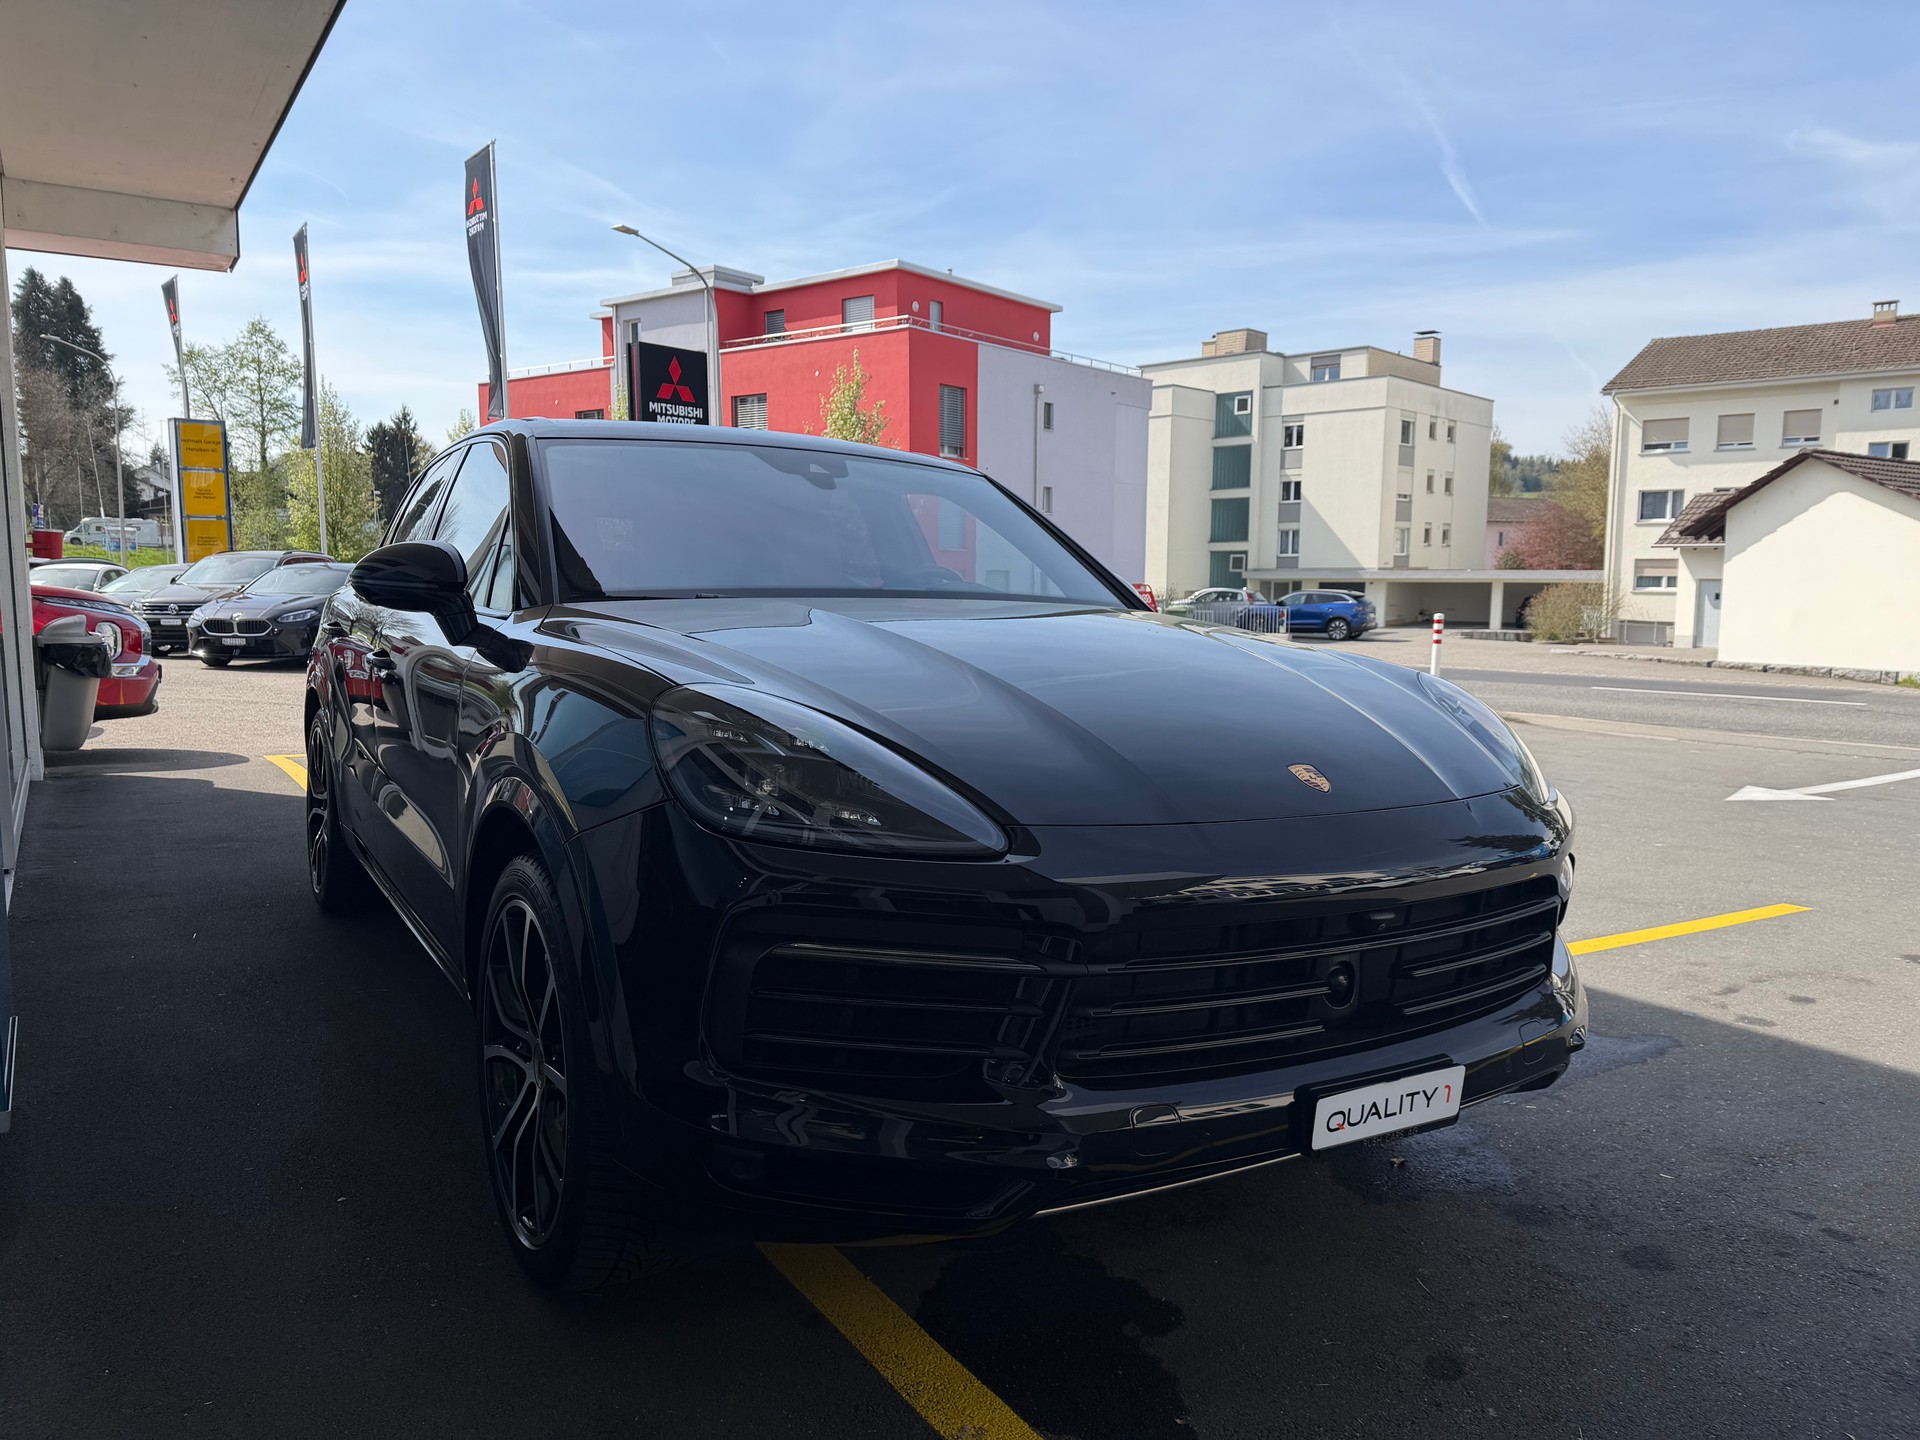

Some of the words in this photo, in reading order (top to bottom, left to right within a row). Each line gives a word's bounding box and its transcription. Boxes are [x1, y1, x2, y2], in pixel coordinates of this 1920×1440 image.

[649, 401, 703, 419] MITSUBISHI
[1326, 1087, 1439, 1133] QUALITY
[1444, 1084, 1452, 1103] 1
[1363, 1136, 1381, 1148] RUSH
[1386, 1130, 1404, 1143] CARS
[1407, 1126, 1418, 1137] AG
